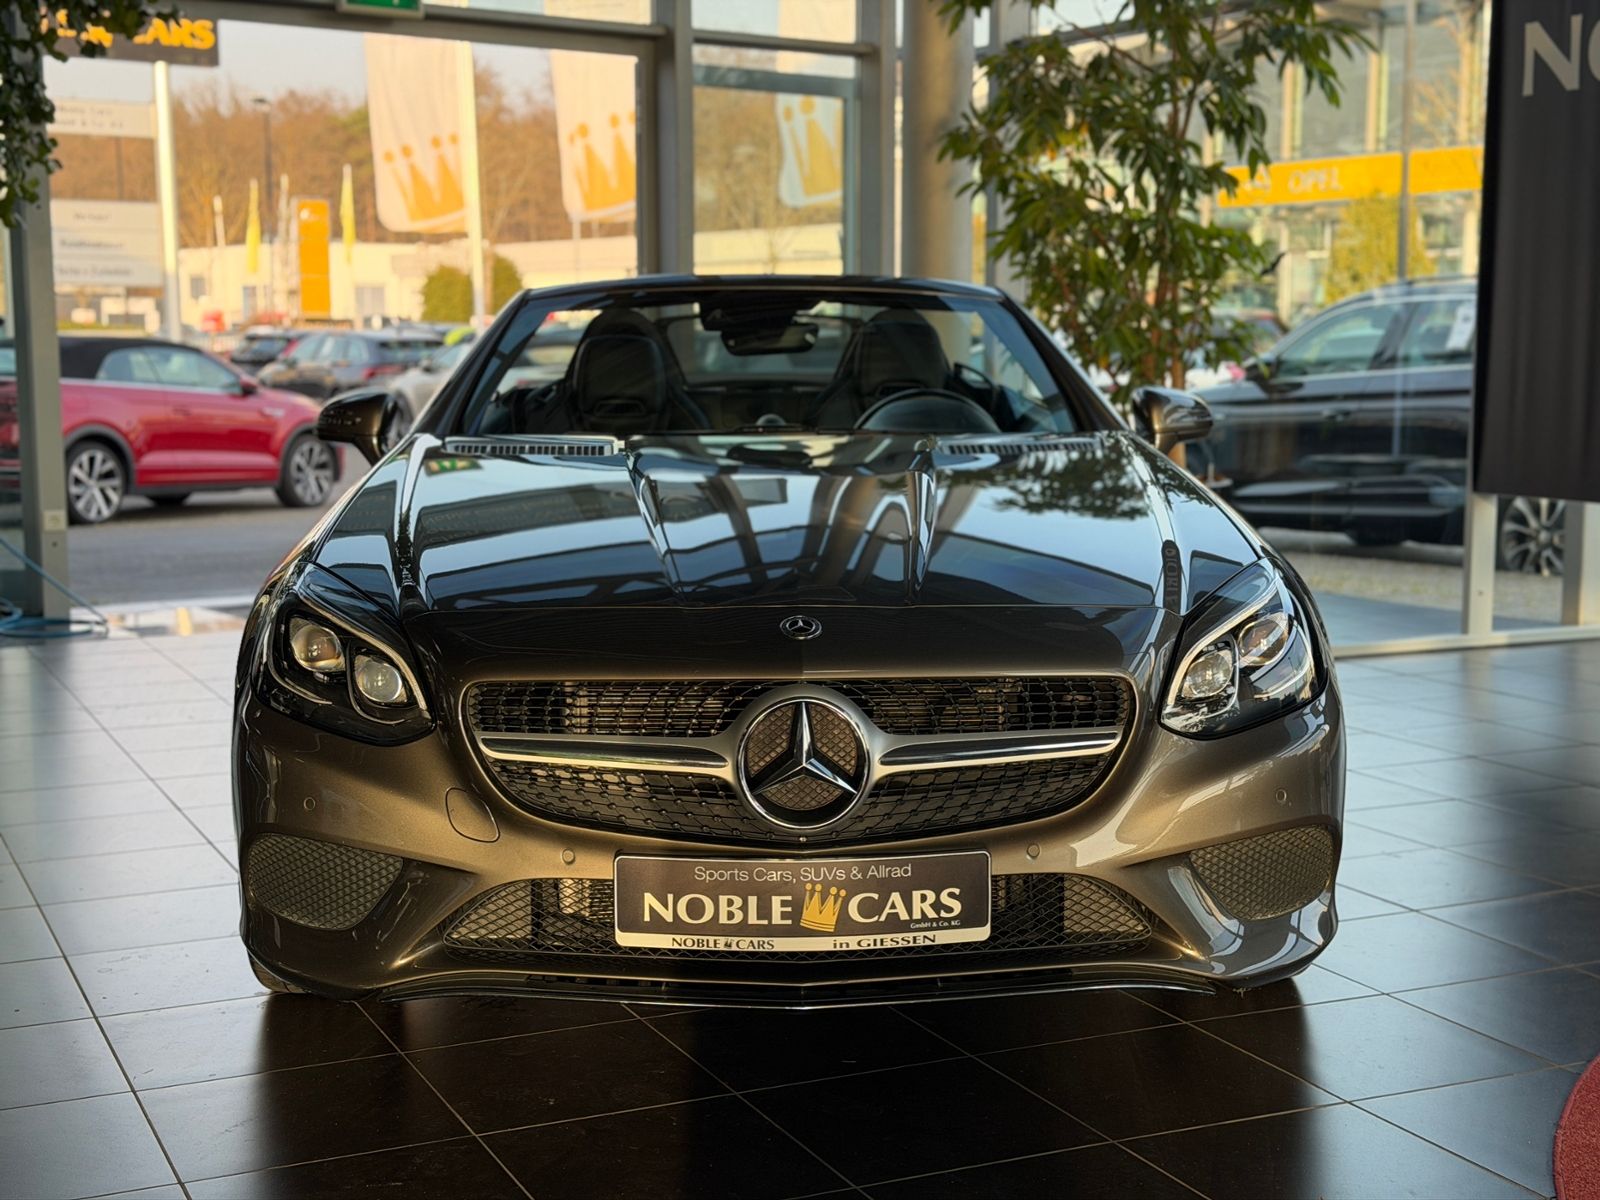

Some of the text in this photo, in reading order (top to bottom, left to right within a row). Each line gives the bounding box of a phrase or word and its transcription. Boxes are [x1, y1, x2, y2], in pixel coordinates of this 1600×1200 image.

[1522, 13, 1600, 96] N
[694, 863, 912, 883] Sports Cars, SUVs & Allrad
[643, 892, 793, 925] NOBLE
[847, 887, 962, 923] CARS
[910, 921, 931, 929] GmbH
[671, 937, 775, 950] NOBLE CARS
[833, 934, 936, 949] in GIESSEN
